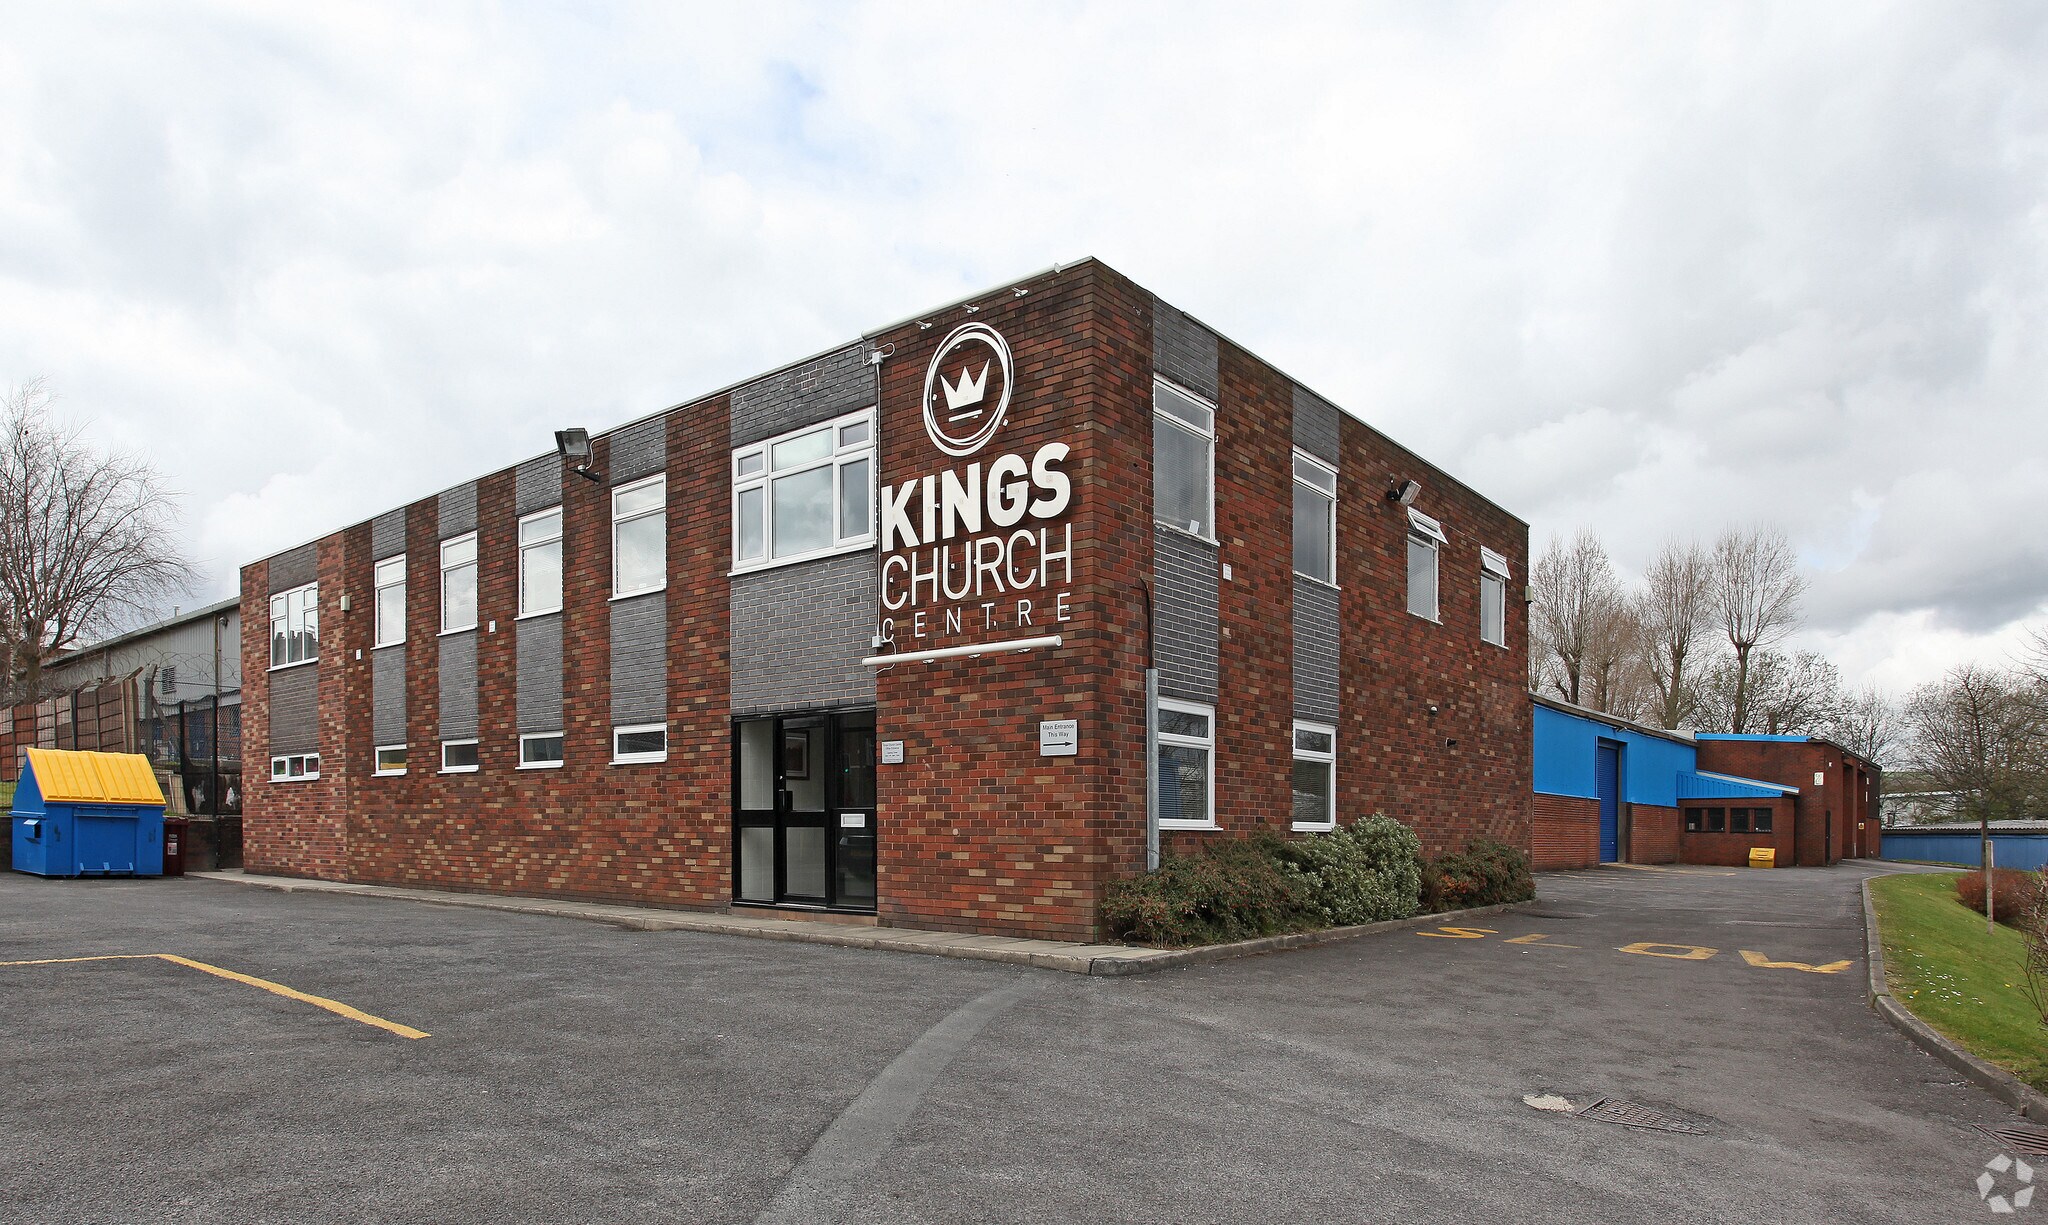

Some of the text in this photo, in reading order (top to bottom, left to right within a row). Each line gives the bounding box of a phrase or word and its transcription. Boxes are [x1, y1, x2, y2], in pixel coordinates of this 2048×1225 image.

[881, 442, 1071, 553] KINGS
[881, 522, 1072, 611] CHURCH
[882, 592, 1071, 642] CENTRE
[1416, 926, 1855, 974] SLOW
